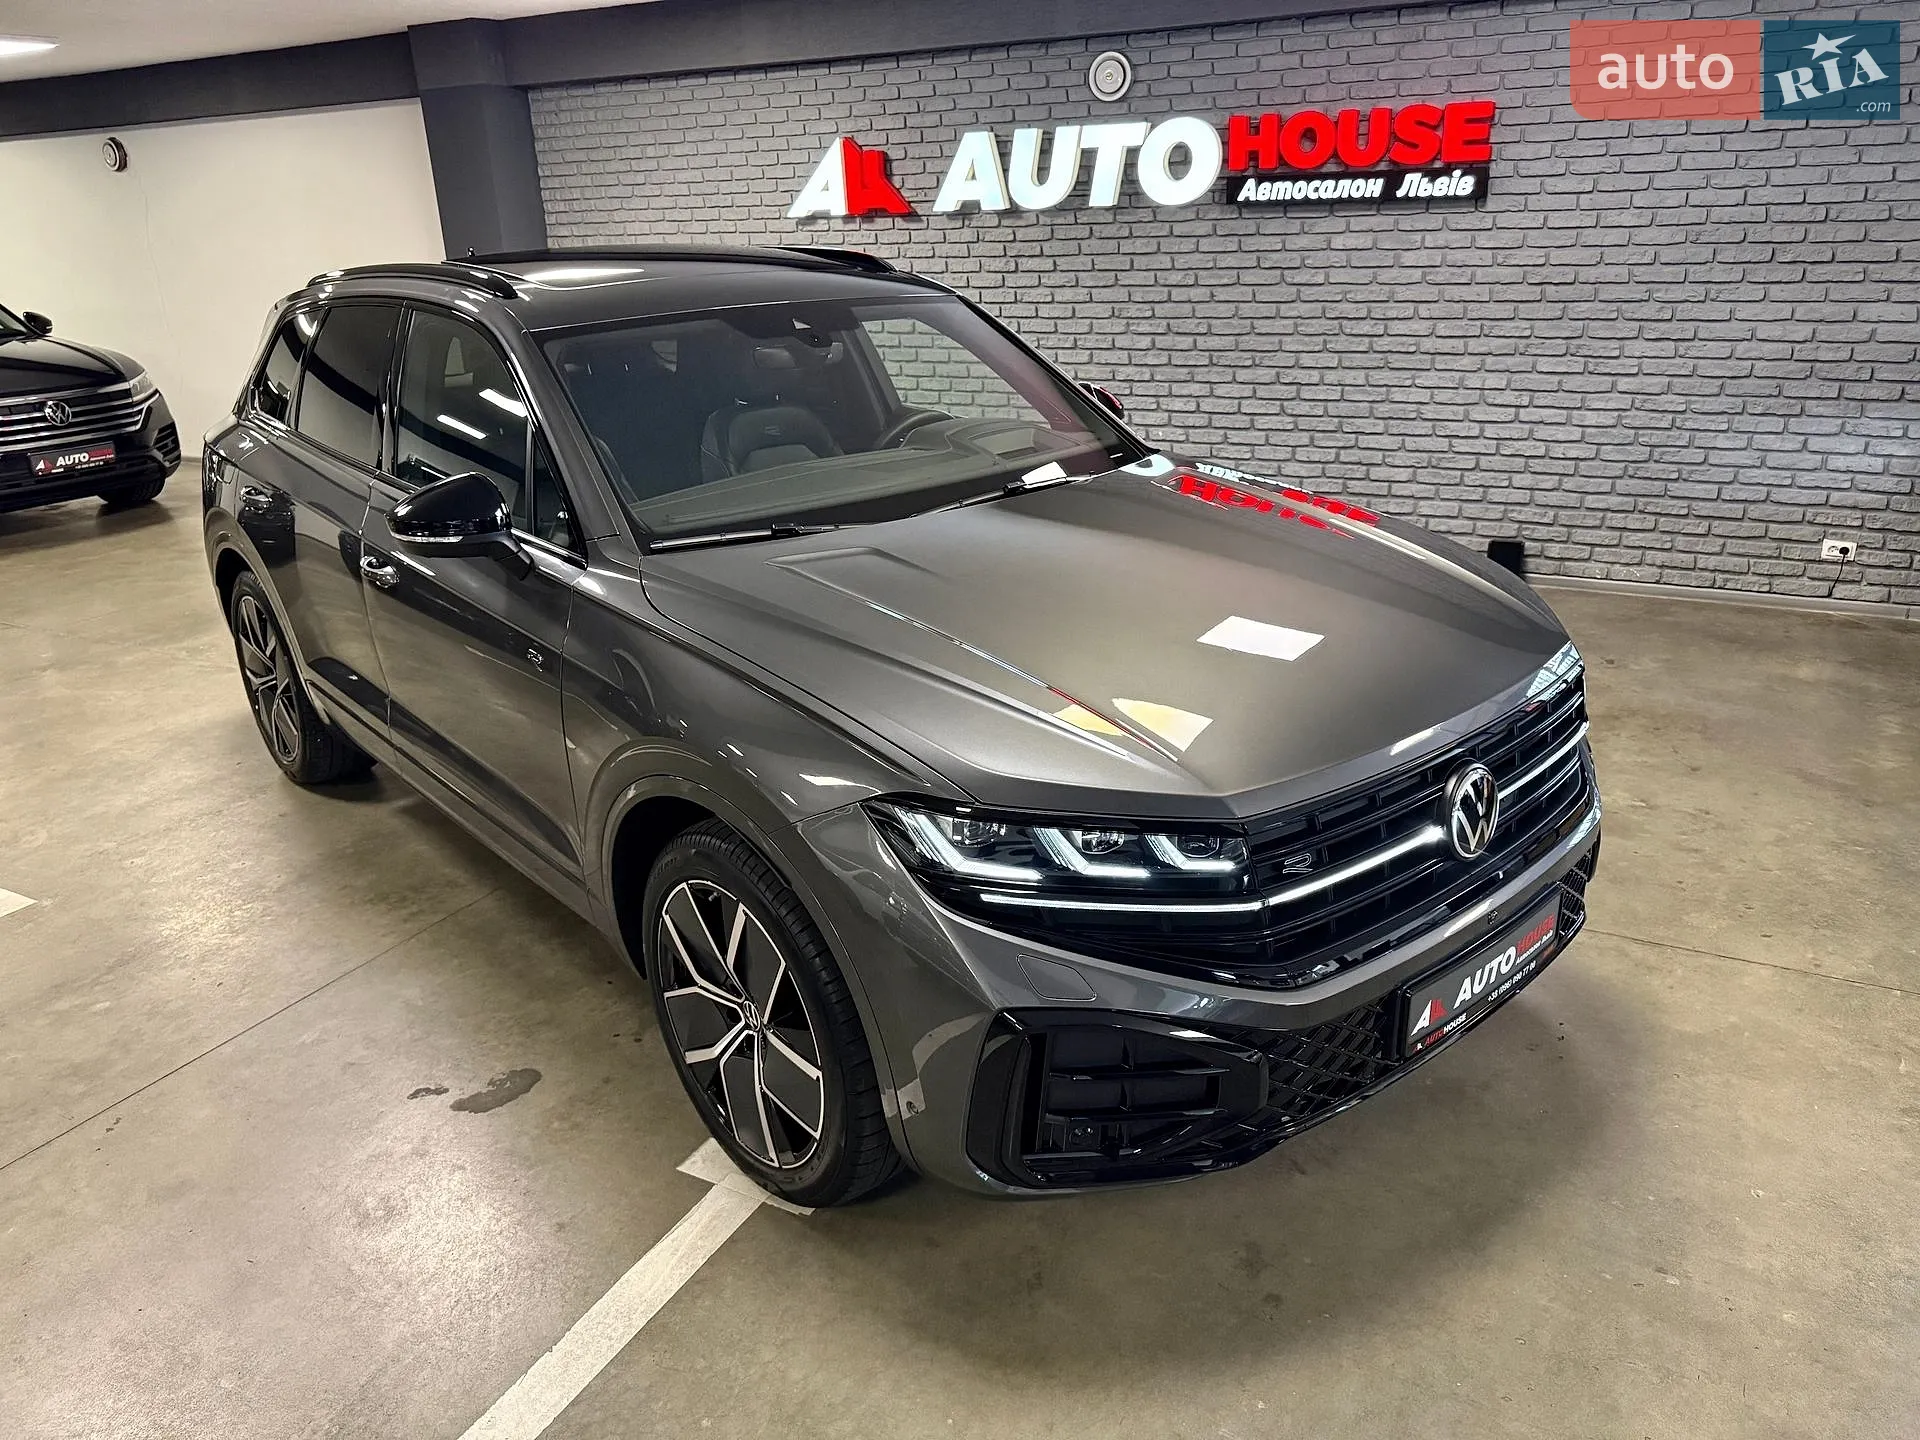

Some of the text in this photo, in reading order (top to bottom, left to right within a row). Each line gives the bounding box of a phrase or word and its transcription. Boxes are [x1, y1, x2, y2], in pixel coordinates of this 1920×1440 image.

[932, 117, 1223, 212] AUTO
[1228, 101, 1496, 172] HOUSE
[1237, 170, 1475, 202] Автосалон Львів
[56, 452, 90, 467] AUTO
[1453, 946, 1516, 1010] AUTO
